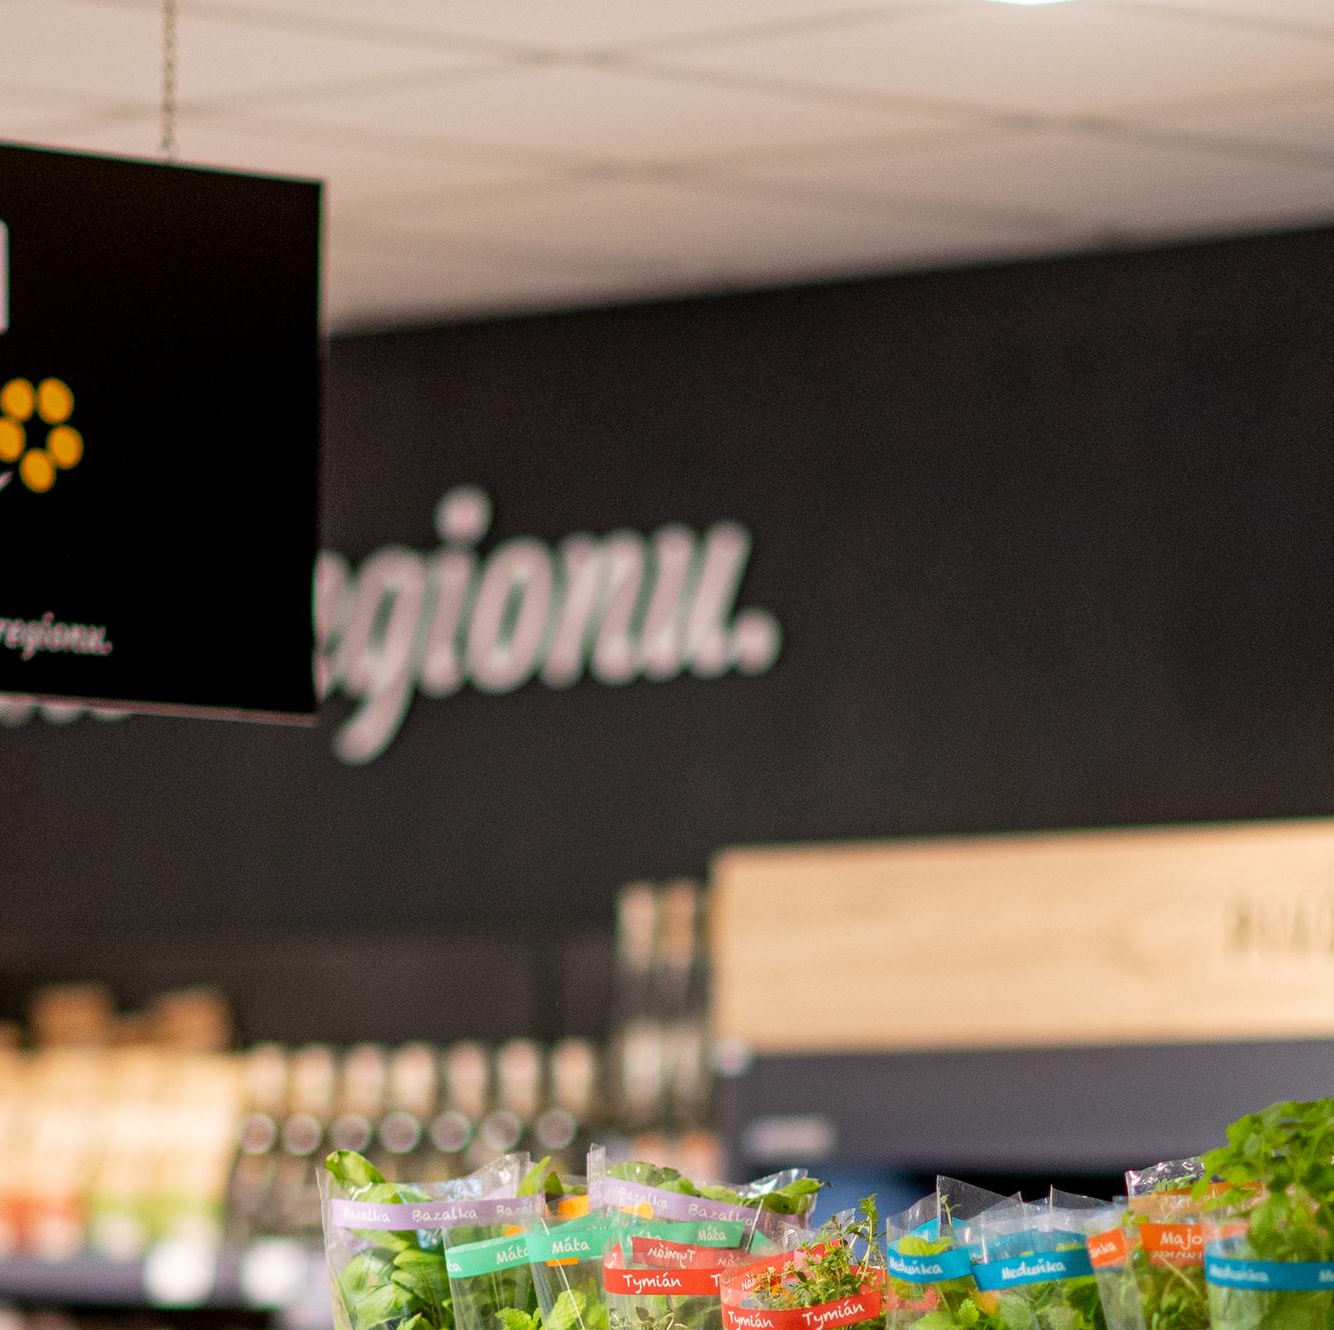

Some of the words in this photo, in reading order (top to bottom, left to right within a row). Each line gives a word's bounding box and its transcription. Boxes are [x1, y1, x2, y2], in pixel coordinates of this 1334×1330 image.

[411, 1207, 480, 1224] Bazalka
[551, 1235, 592, 1256] Máta
[696, 1226, 728, 1243] Máta
[1001, 1257, 1067, 1281] Meduňka
[622, 1272, 682, 1295] Tymián
[802, 1298, 866, 1330] Tymián
